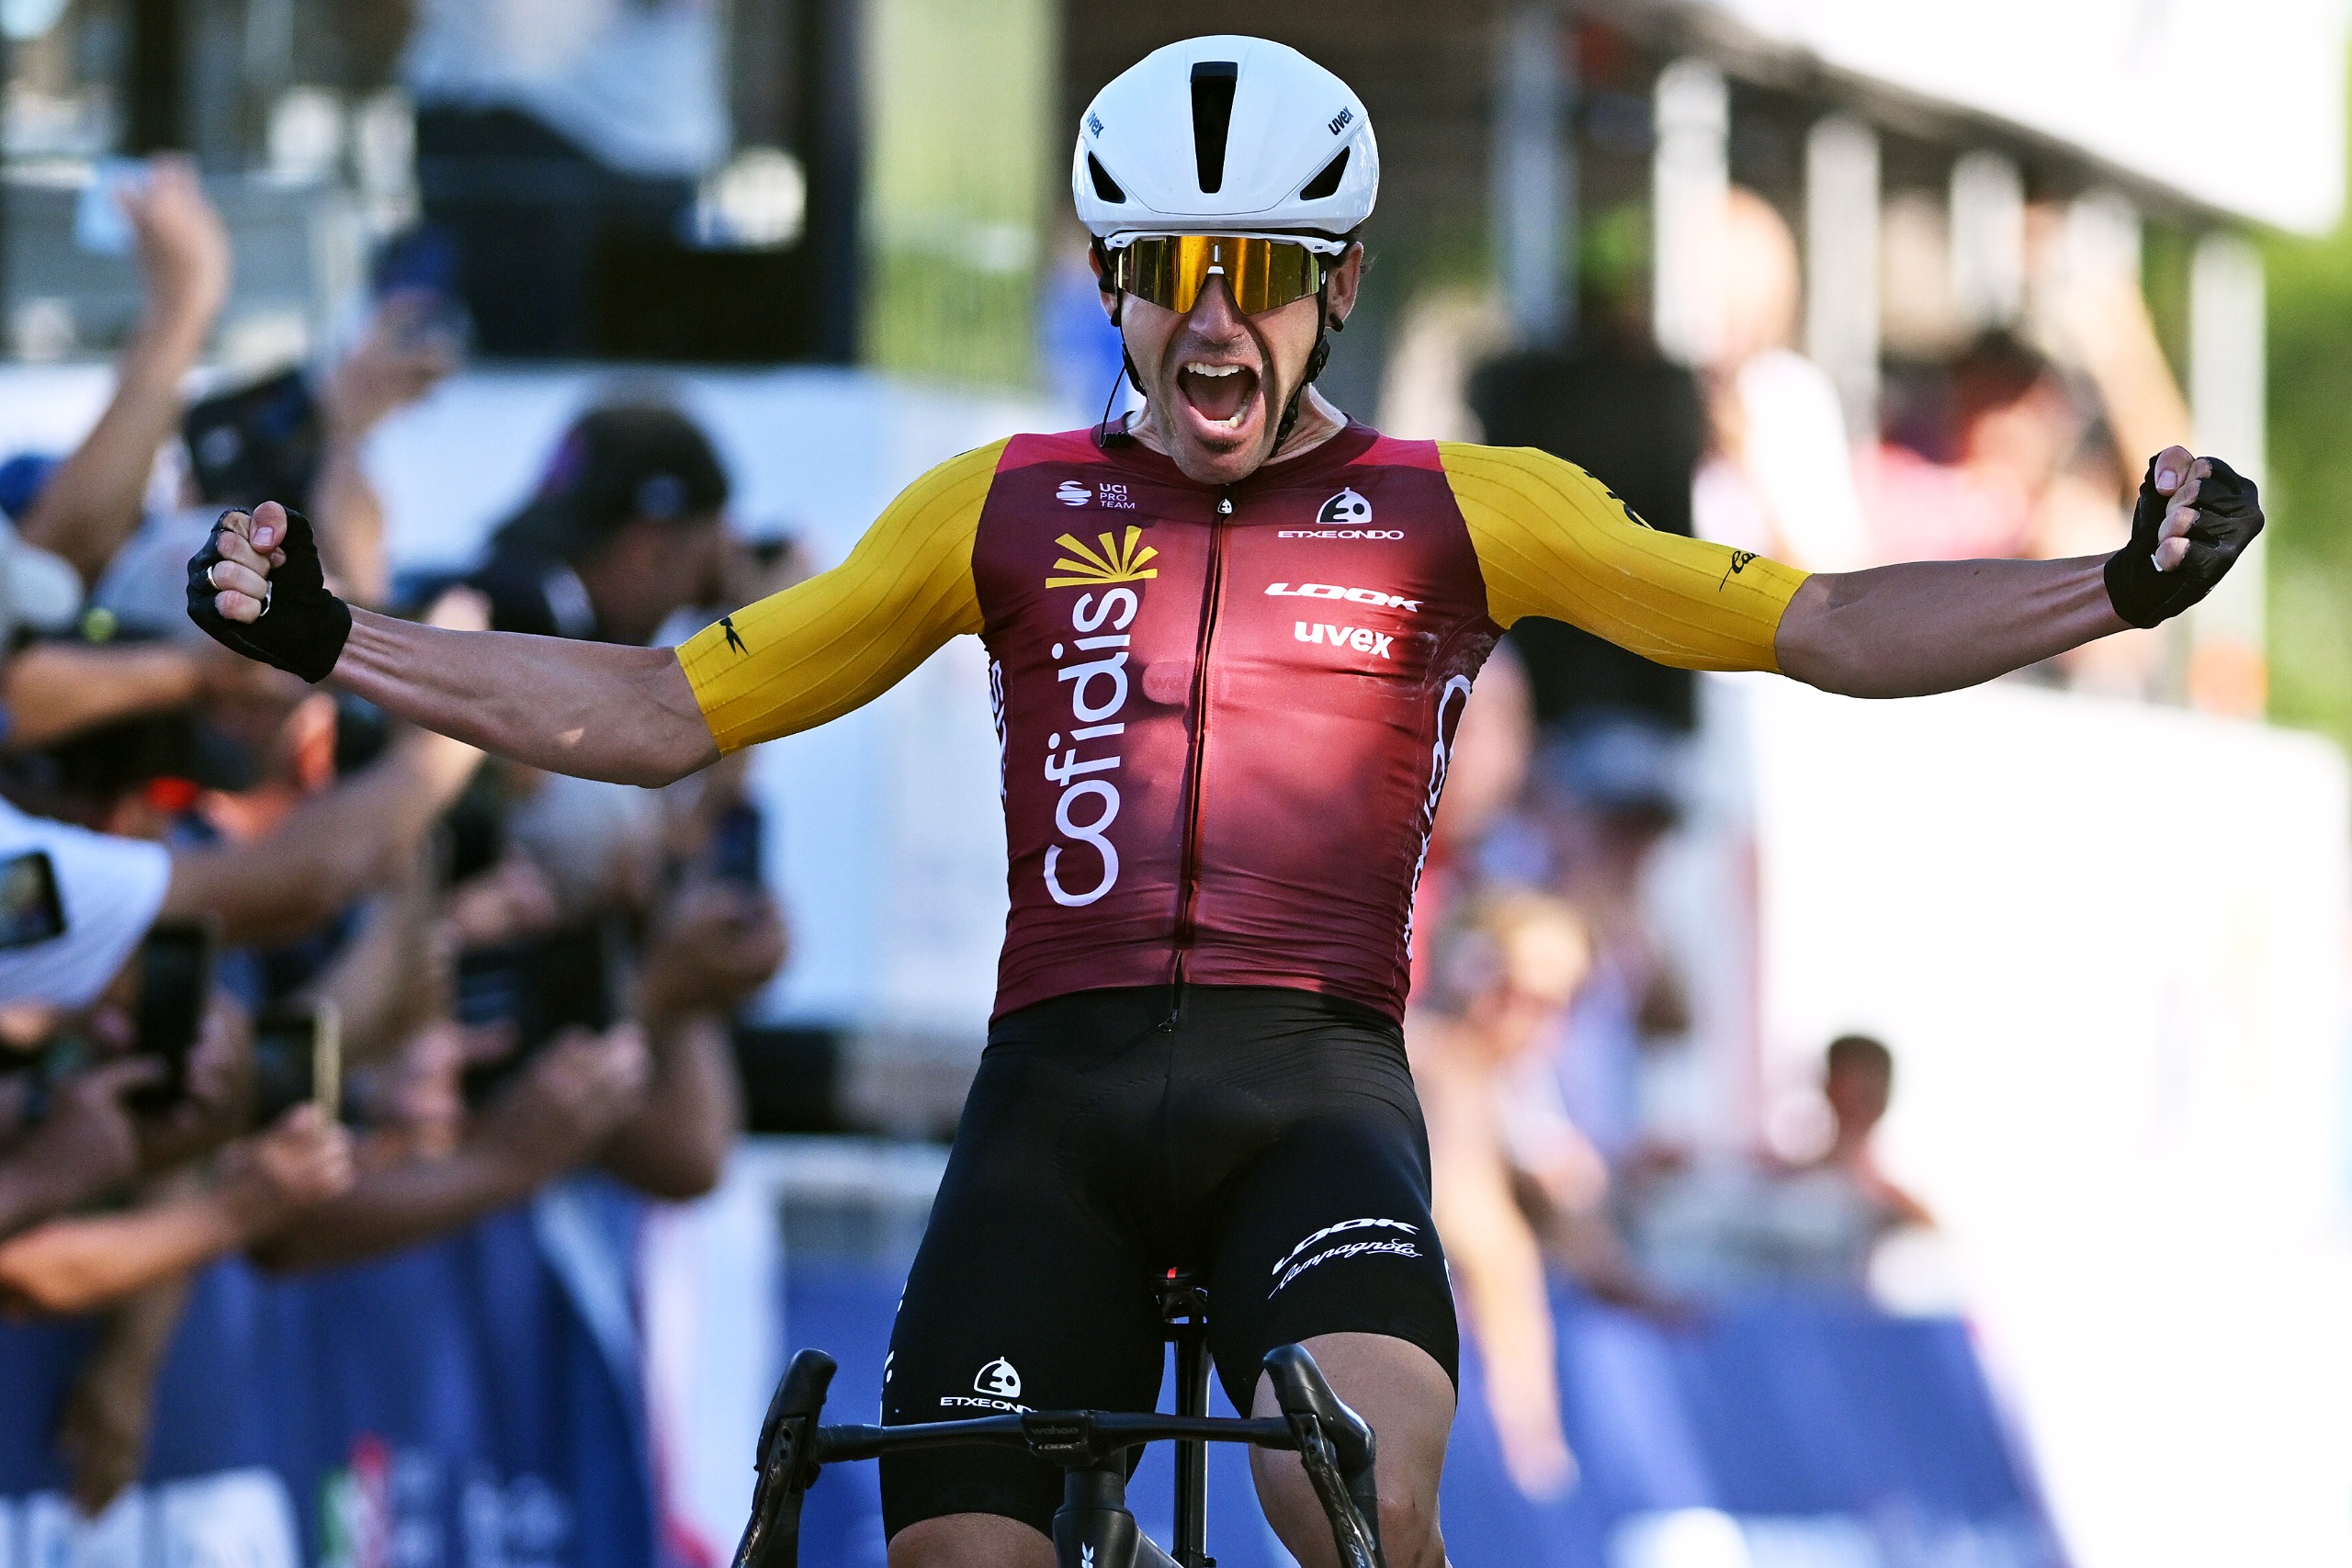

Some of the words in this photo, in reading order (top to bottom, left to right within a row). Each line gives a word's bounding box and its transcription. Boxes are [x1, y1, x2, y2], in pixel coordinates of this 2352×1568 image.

[1327, 106, 1354, 136] uvex
[1099, 482, 1127, 494] UCI
[1100, 492, 1127, 502] PRO
[1100, 501, 1136, 509] TEAM
[1277, 530, 1405, 540] ETXEONDO
[1263, 582, 1425, 613] LOOK
[1294, 620, 1395, 660] uvex
[1044, 586, 1139, 908] Cofidis
[1272, 1218, 1420, 1275] LOOK
[1268, 1238, 1423, 1300] Campagnolo
